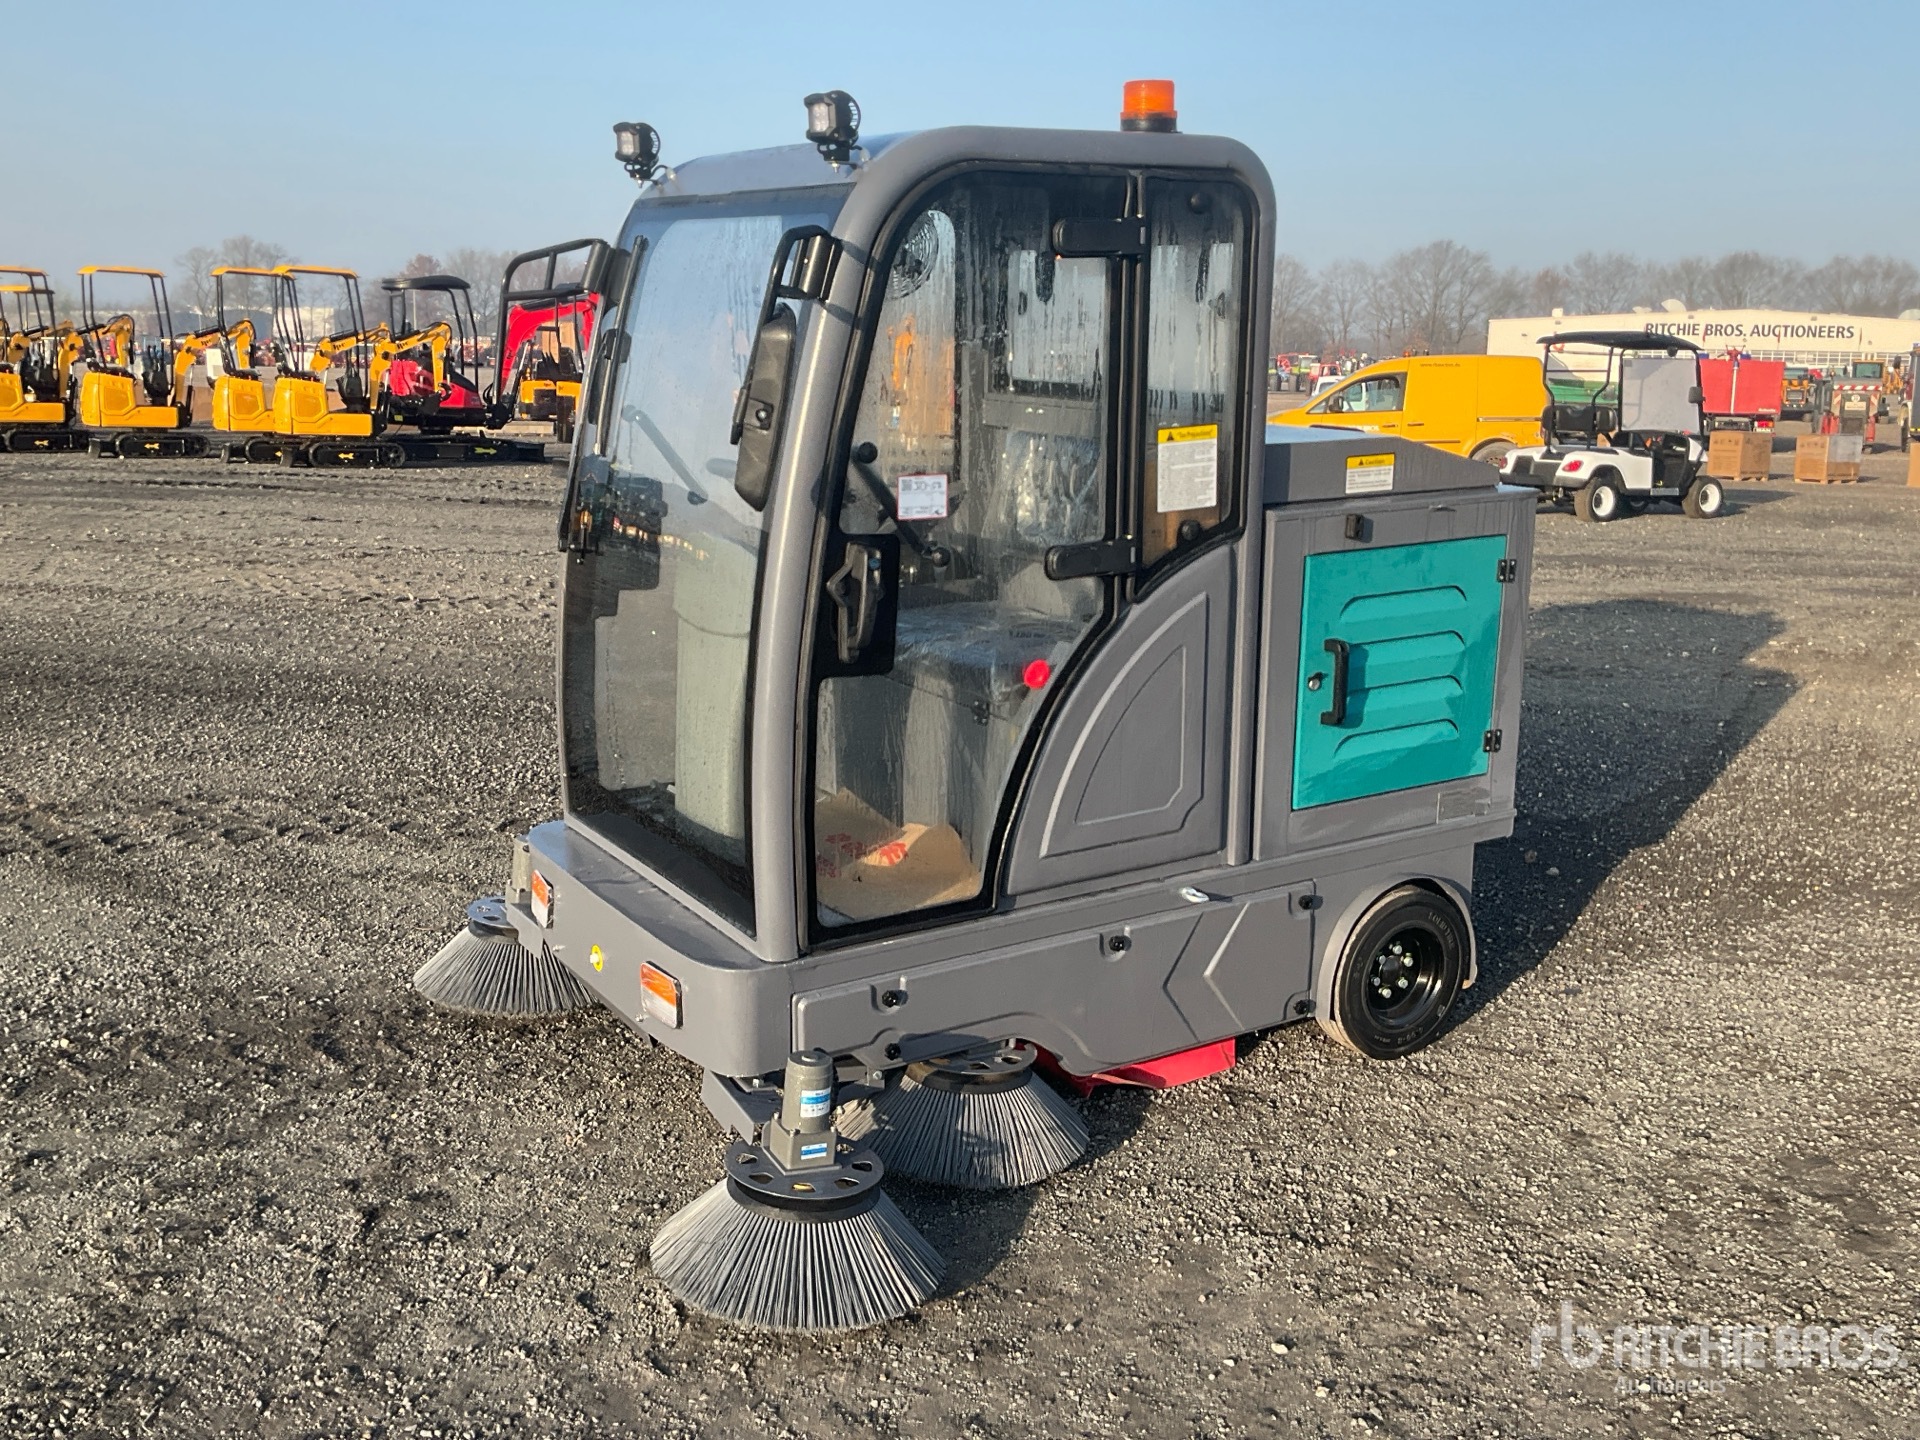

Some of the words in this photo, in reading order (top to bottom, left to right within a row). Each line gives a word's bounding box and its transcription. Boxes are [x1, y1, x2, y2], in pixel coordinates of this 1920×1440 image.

[1645, 322, 1700, 336] RITCHIE
[1705, 323, 1747, 337] BROS.
[1749, 323, 1855, 339] AUCTIONEERS
